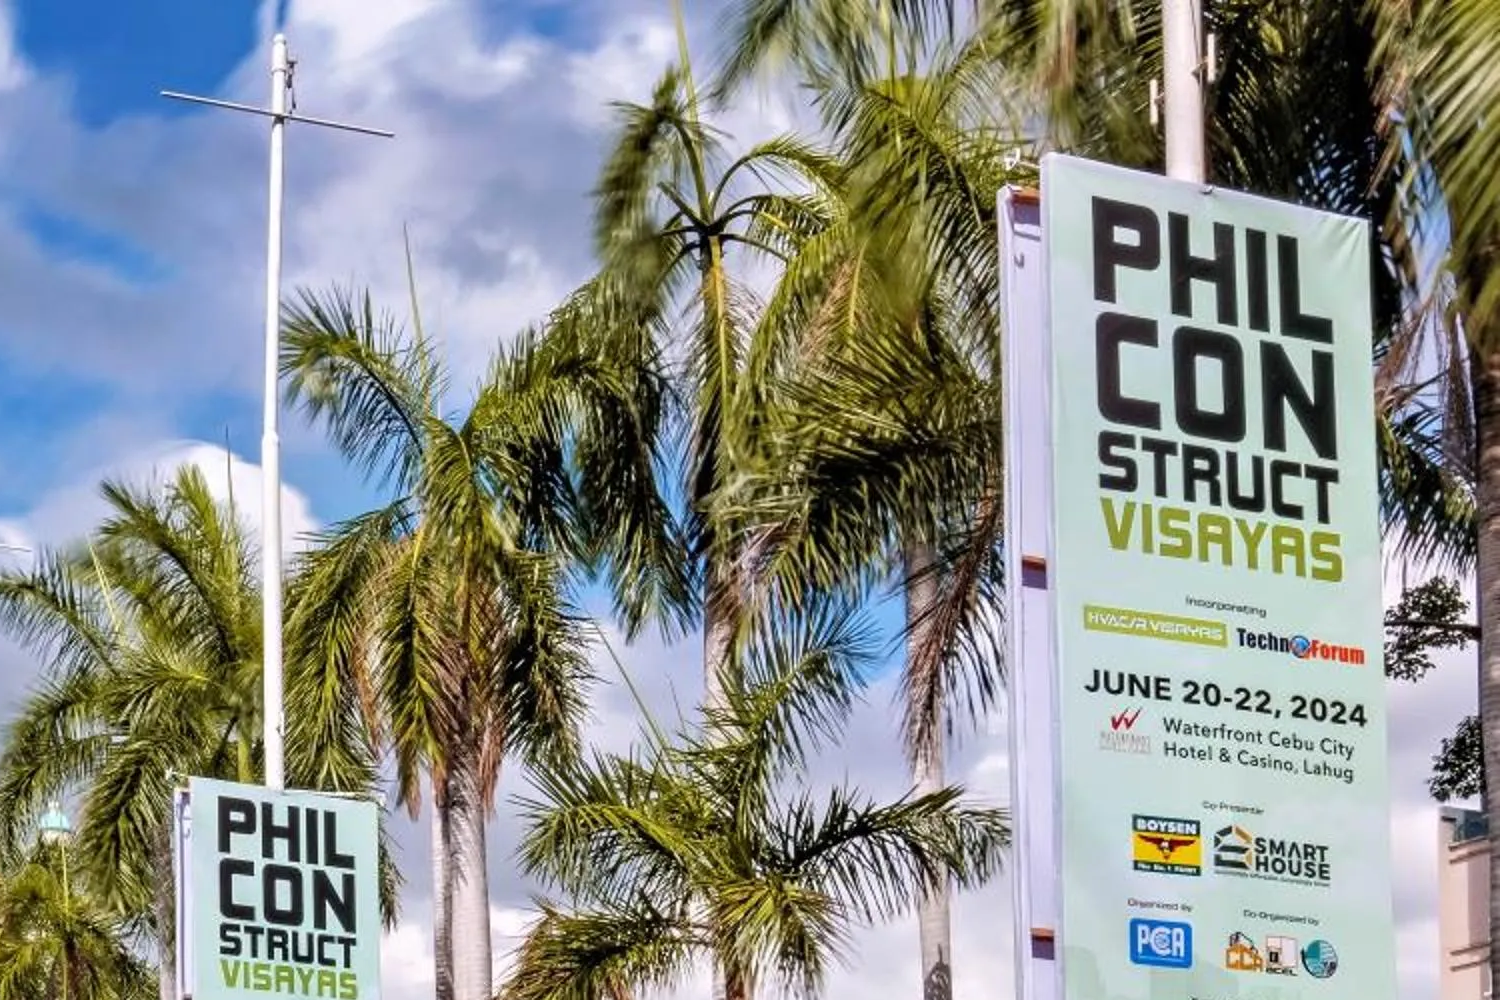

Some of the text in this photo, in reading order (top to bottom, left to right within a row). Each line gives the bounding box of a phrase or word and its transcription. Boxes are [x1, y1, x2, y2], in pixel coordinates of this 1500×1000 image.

[1091, 195, 1334, 345] PHIL
[1095, 311, 1338, 461] CON
[1098, 429, 1341, 525] STRUCT
[1100, 496, 1344, 583] VISAYAS
[1084, 669, 1368, 728] JUNE 20-22, 2024
[1163, 716, 1263, 745] Waterfront
[1268, 727, 1315, 752] Cebu
[1319, 734, 1355, 761] City
[1163, 742, 1213, 761] Hotel
[1218, 747, 1232, 764] &
[1237, 751, 1299, 775] Casino,
[1303, 756, 1355, 784] Lahug
[217, 795, 356, 870] PHIL
[1254, 837, 1329, 862] SMART
[1255, 855, 1331, 881] HOUSE
[219, 858, 356, 934] CON
[219, 922, 357, 969] STRUCT
[1137, 924, 1185, 957] PCA
[220, 959, 358, 1000] VISAYAS
